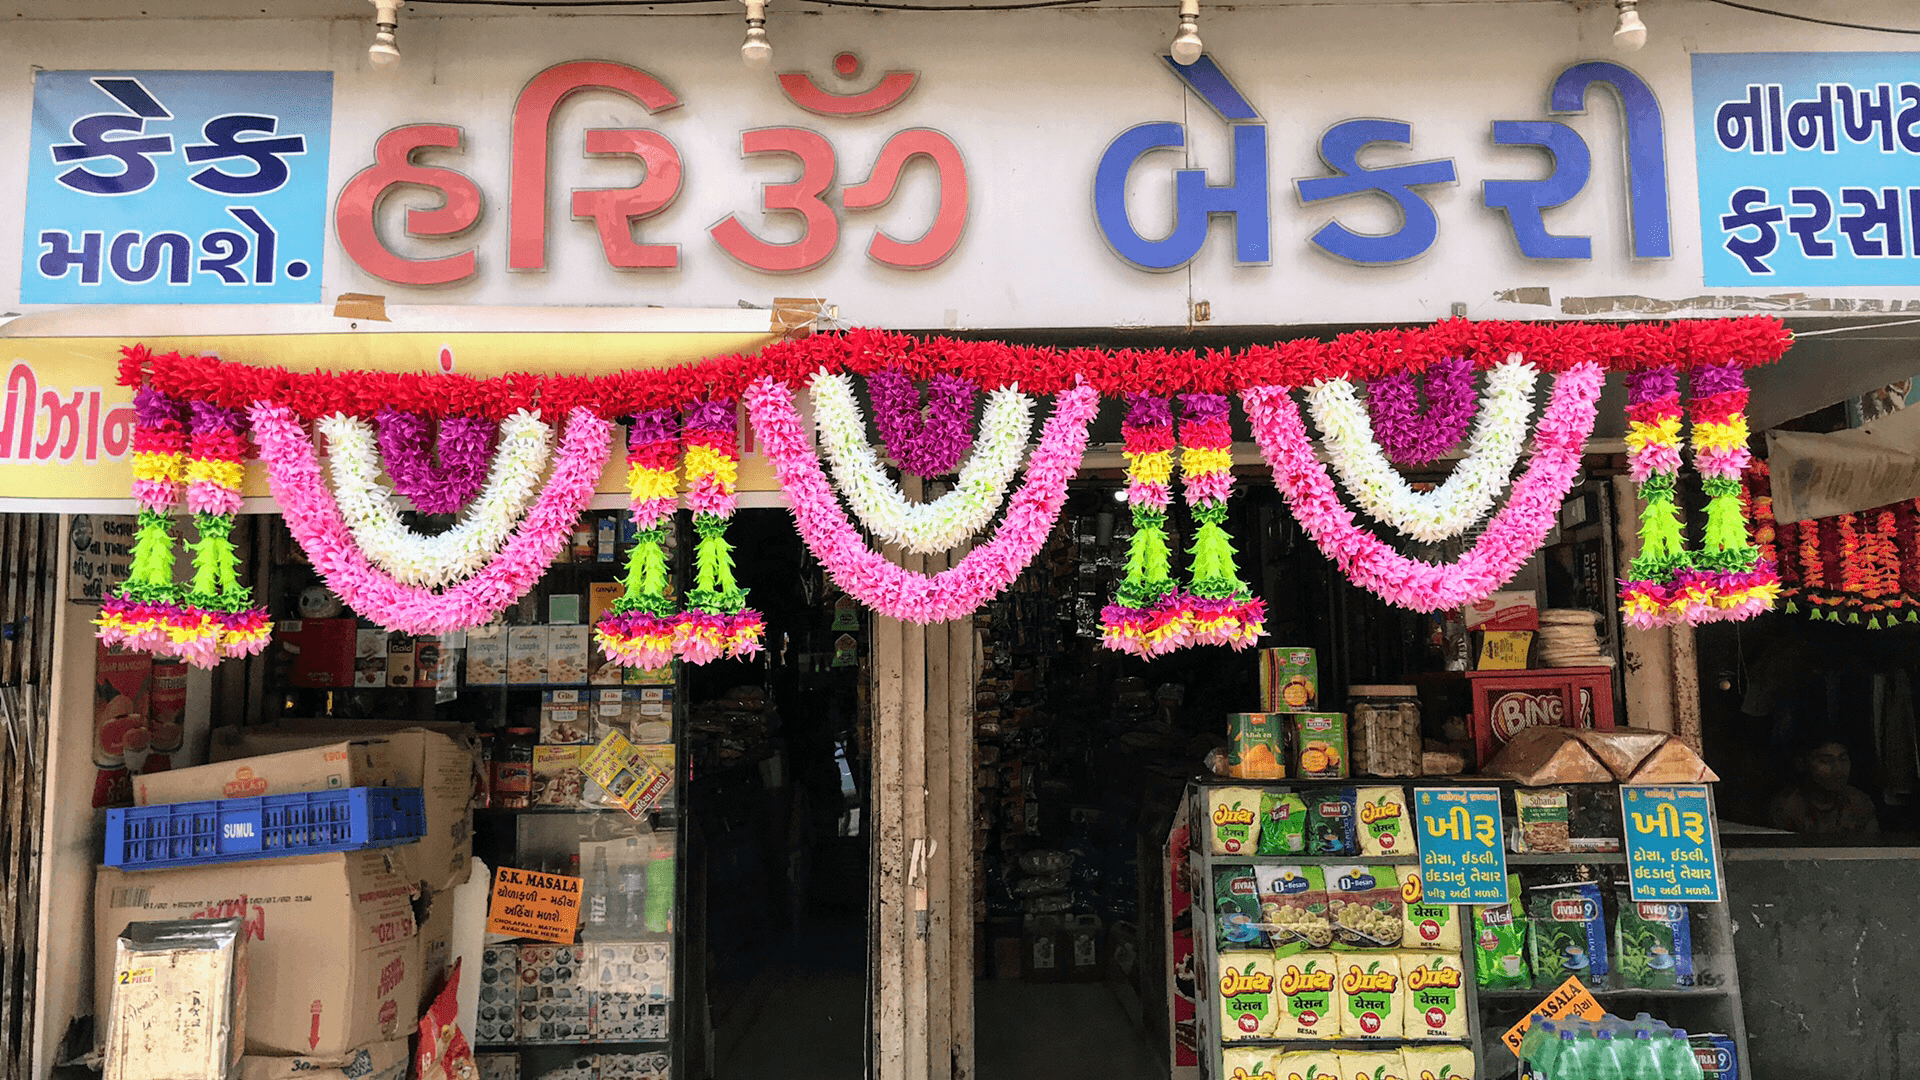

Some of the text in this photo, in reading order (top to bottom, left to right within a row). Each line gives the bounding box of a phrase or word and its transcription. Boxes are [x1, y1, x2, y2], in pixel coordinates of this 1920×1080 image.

[50, 77, 305, 195] કેક
[1094, 54, 1673, 271] બેકરી
[557, 691, 573, 700] Gits
[604, 691, 618, 699] Gits
[645, 690, 659, 698] Gits
[1530, 796, 1556, 806] Suhana
[1341, 805, 1348, 814] 9
[223, 822, 255, 839] SUMUL
[1470, 867, 1501, 882] તૈયાર
[1680, 864, 1711, 879] તૈયાર
[499, 870, 579, 893] S.K. MASALA
[496, 887, 537, 902] ચોળાફળી
[589, 896, 607, 922] FIZZ
[1557, 903, 1593, 917] JIVRAJ 9
[1668, 904, 1677, 918] 9
[1485, 909, 1512, 925] Tulsi
[494, 918, 533, 928] CHOLAFALI
[538, 924, 569, 933] MATHIYA
[501, 925, 538, 935] AVAILABLE
[121, 971, 153, 985] 2 PIECE
[1508, 983, 1581, 1047] S.K ASALA
[1696, 1053, 1726, 1066] VRAJ 9
